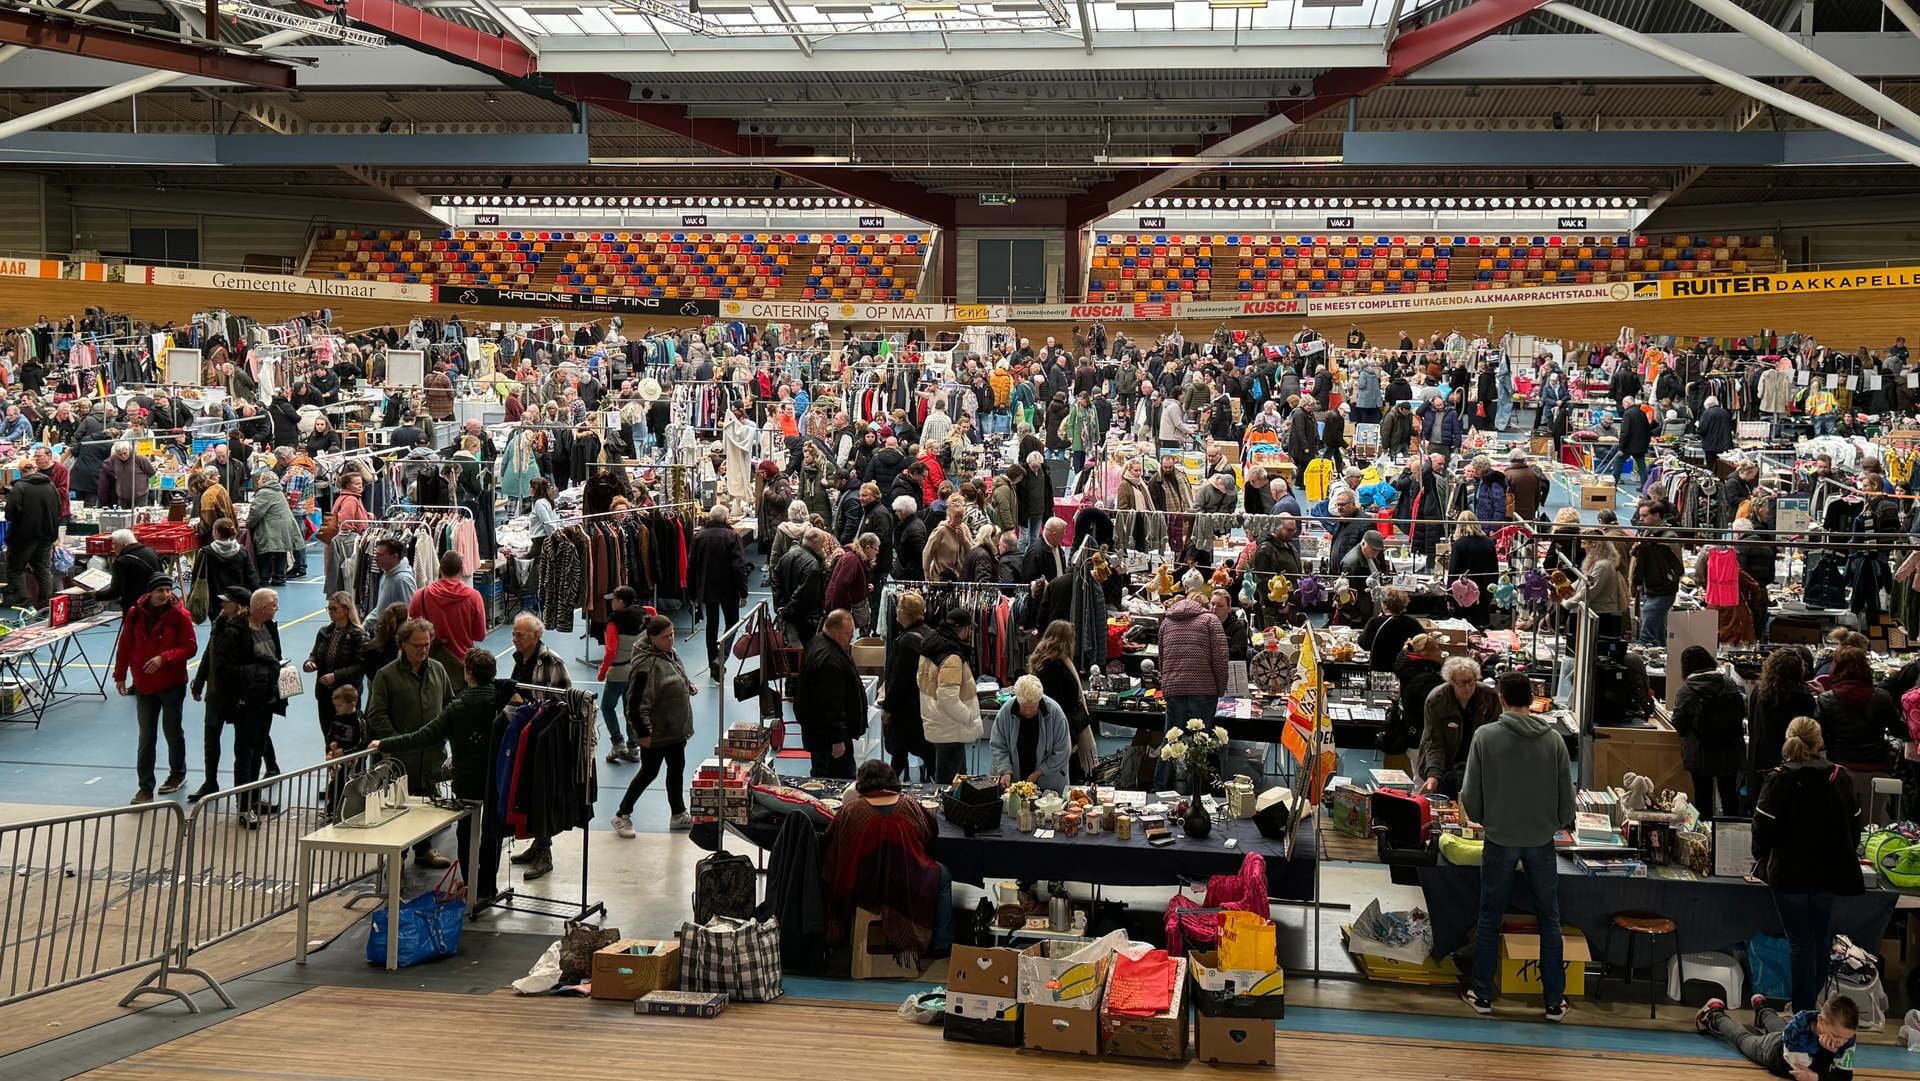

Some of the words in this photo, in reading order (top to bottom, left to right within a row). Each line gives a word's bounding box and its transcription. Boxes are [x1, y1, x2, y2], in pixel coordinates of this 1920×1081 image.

[212, 273, 296, 292] Gemeente
[306, 279, 376, 297] Alkmaar
[1673, 277, 1770, 296] RUITER
[498, 291, 573, 303] KROONE
[579, 295, 660, 307] LIEFTING
[1310, 303, 1322, 311] DE
[1324, 301, 1357, 310] MEEST
[1358, 299, 1411, 309] COMPLETE
[1413, 297, 1473, 307] UITAGENDA:
[1474, 289, 1609, 304] ALKMAARPRACHTSTAD.NL
[752, 304, 829, 318] CATERING
[865, 306, 888, 318] OP
[892, 307, 934, 320] MAAT
[944, 303, 1001, 320] Henry's
[1071, 305, 1123, 317] KUSCH
[1243, 301, 1298, 314] KUSCH
